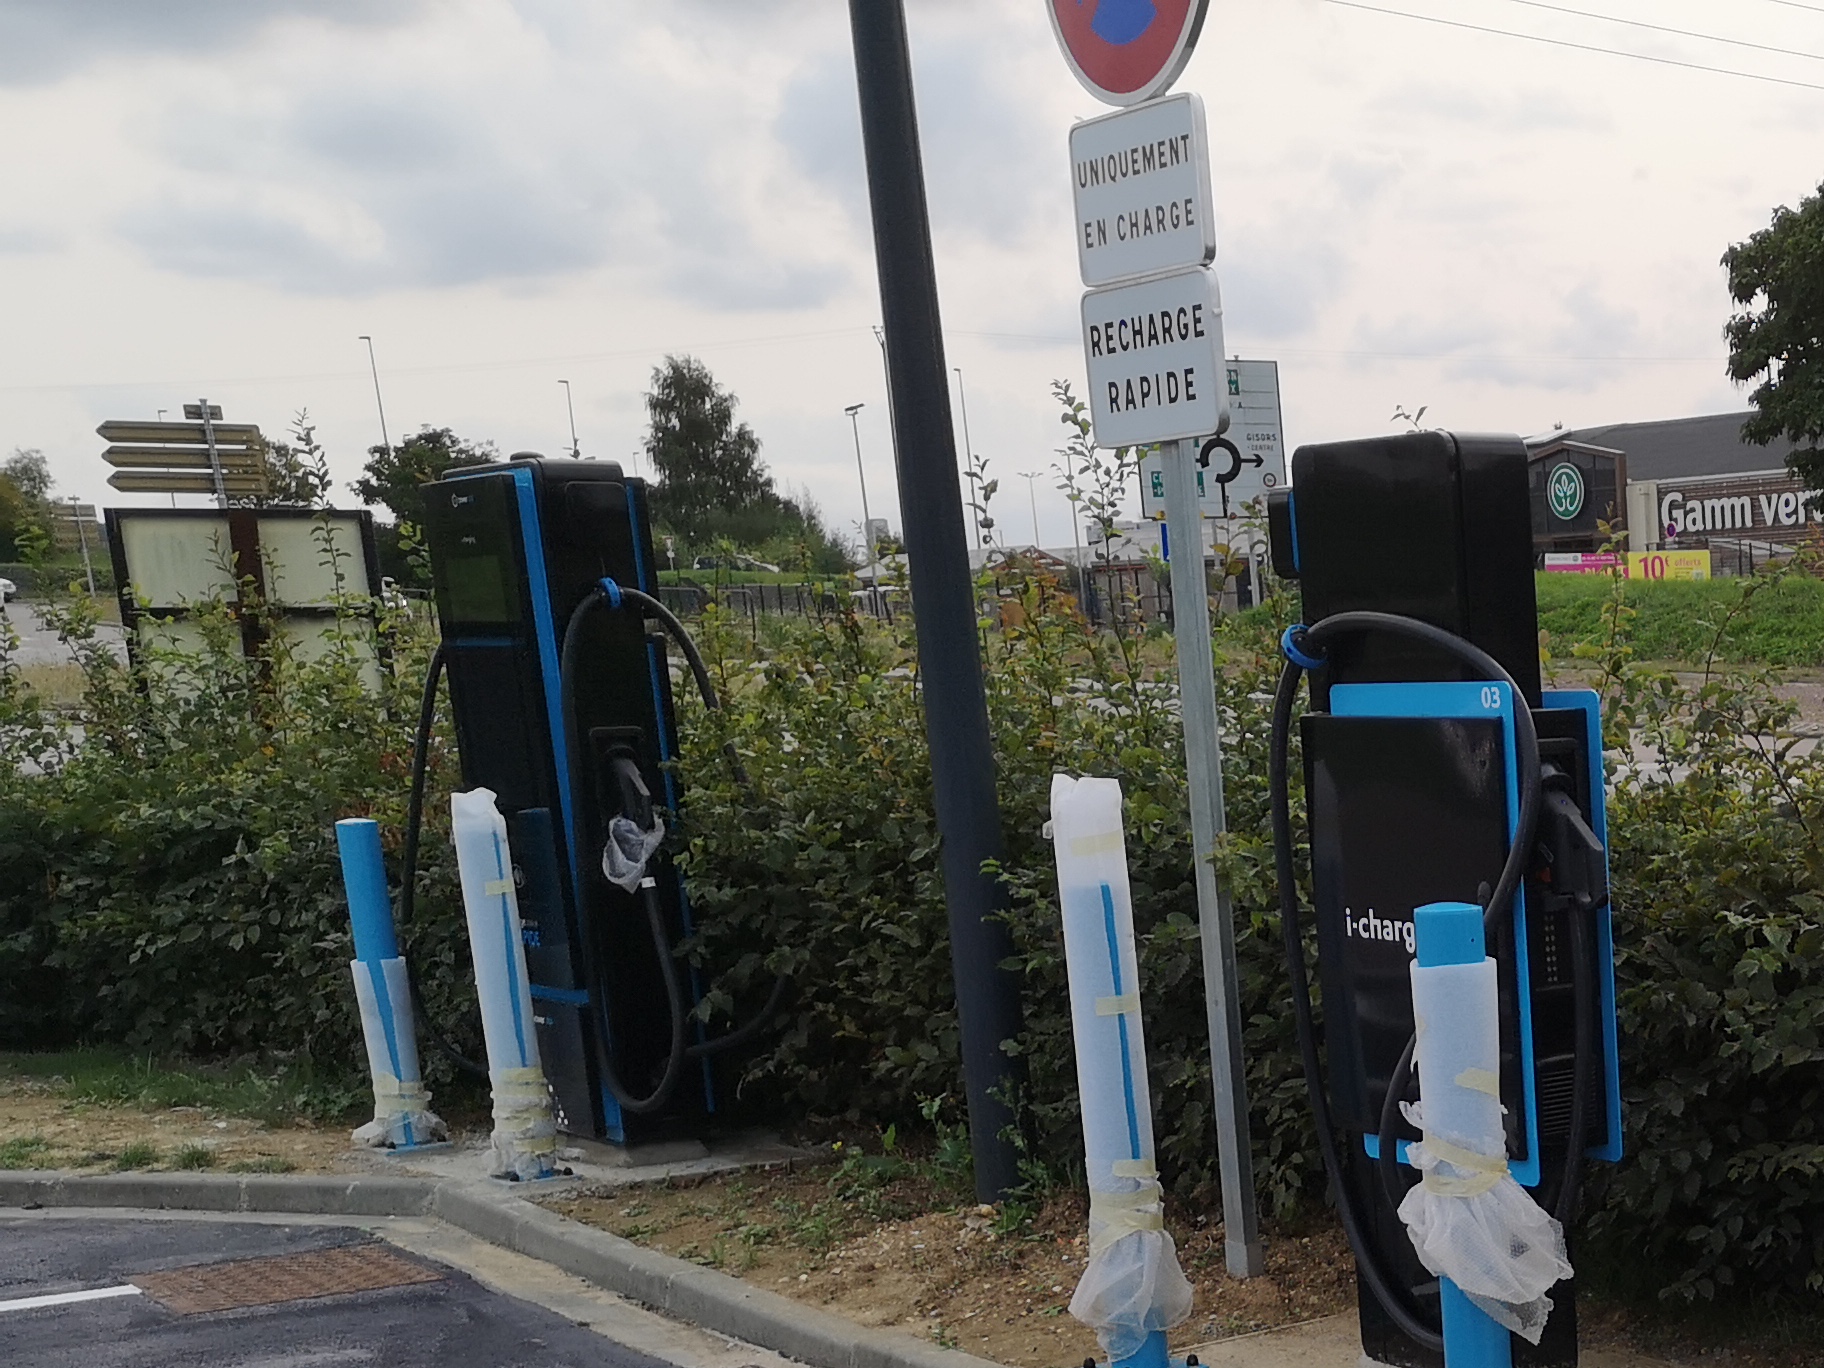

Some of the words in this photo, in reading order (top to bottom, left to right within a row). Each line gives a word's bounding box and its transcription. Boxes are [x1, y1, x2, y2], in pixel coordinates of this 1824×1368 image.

[1077, 133, 1190, 189] UNIQUEMENT
[1084, 218, 1107, 249] EN
[1116, 198, 1195, 241] CHARGE
[1089, 303, 1205, 358] RECHARGE
[1107, 367, 1197, 414] RAPIDE
[1246, 432, 1278, 442] GISORS
[1660, 491, 1754, 533] Gamm
[1480, 686, 1501, 709] 03
[1345, 907, 1416, 954] i-charg
